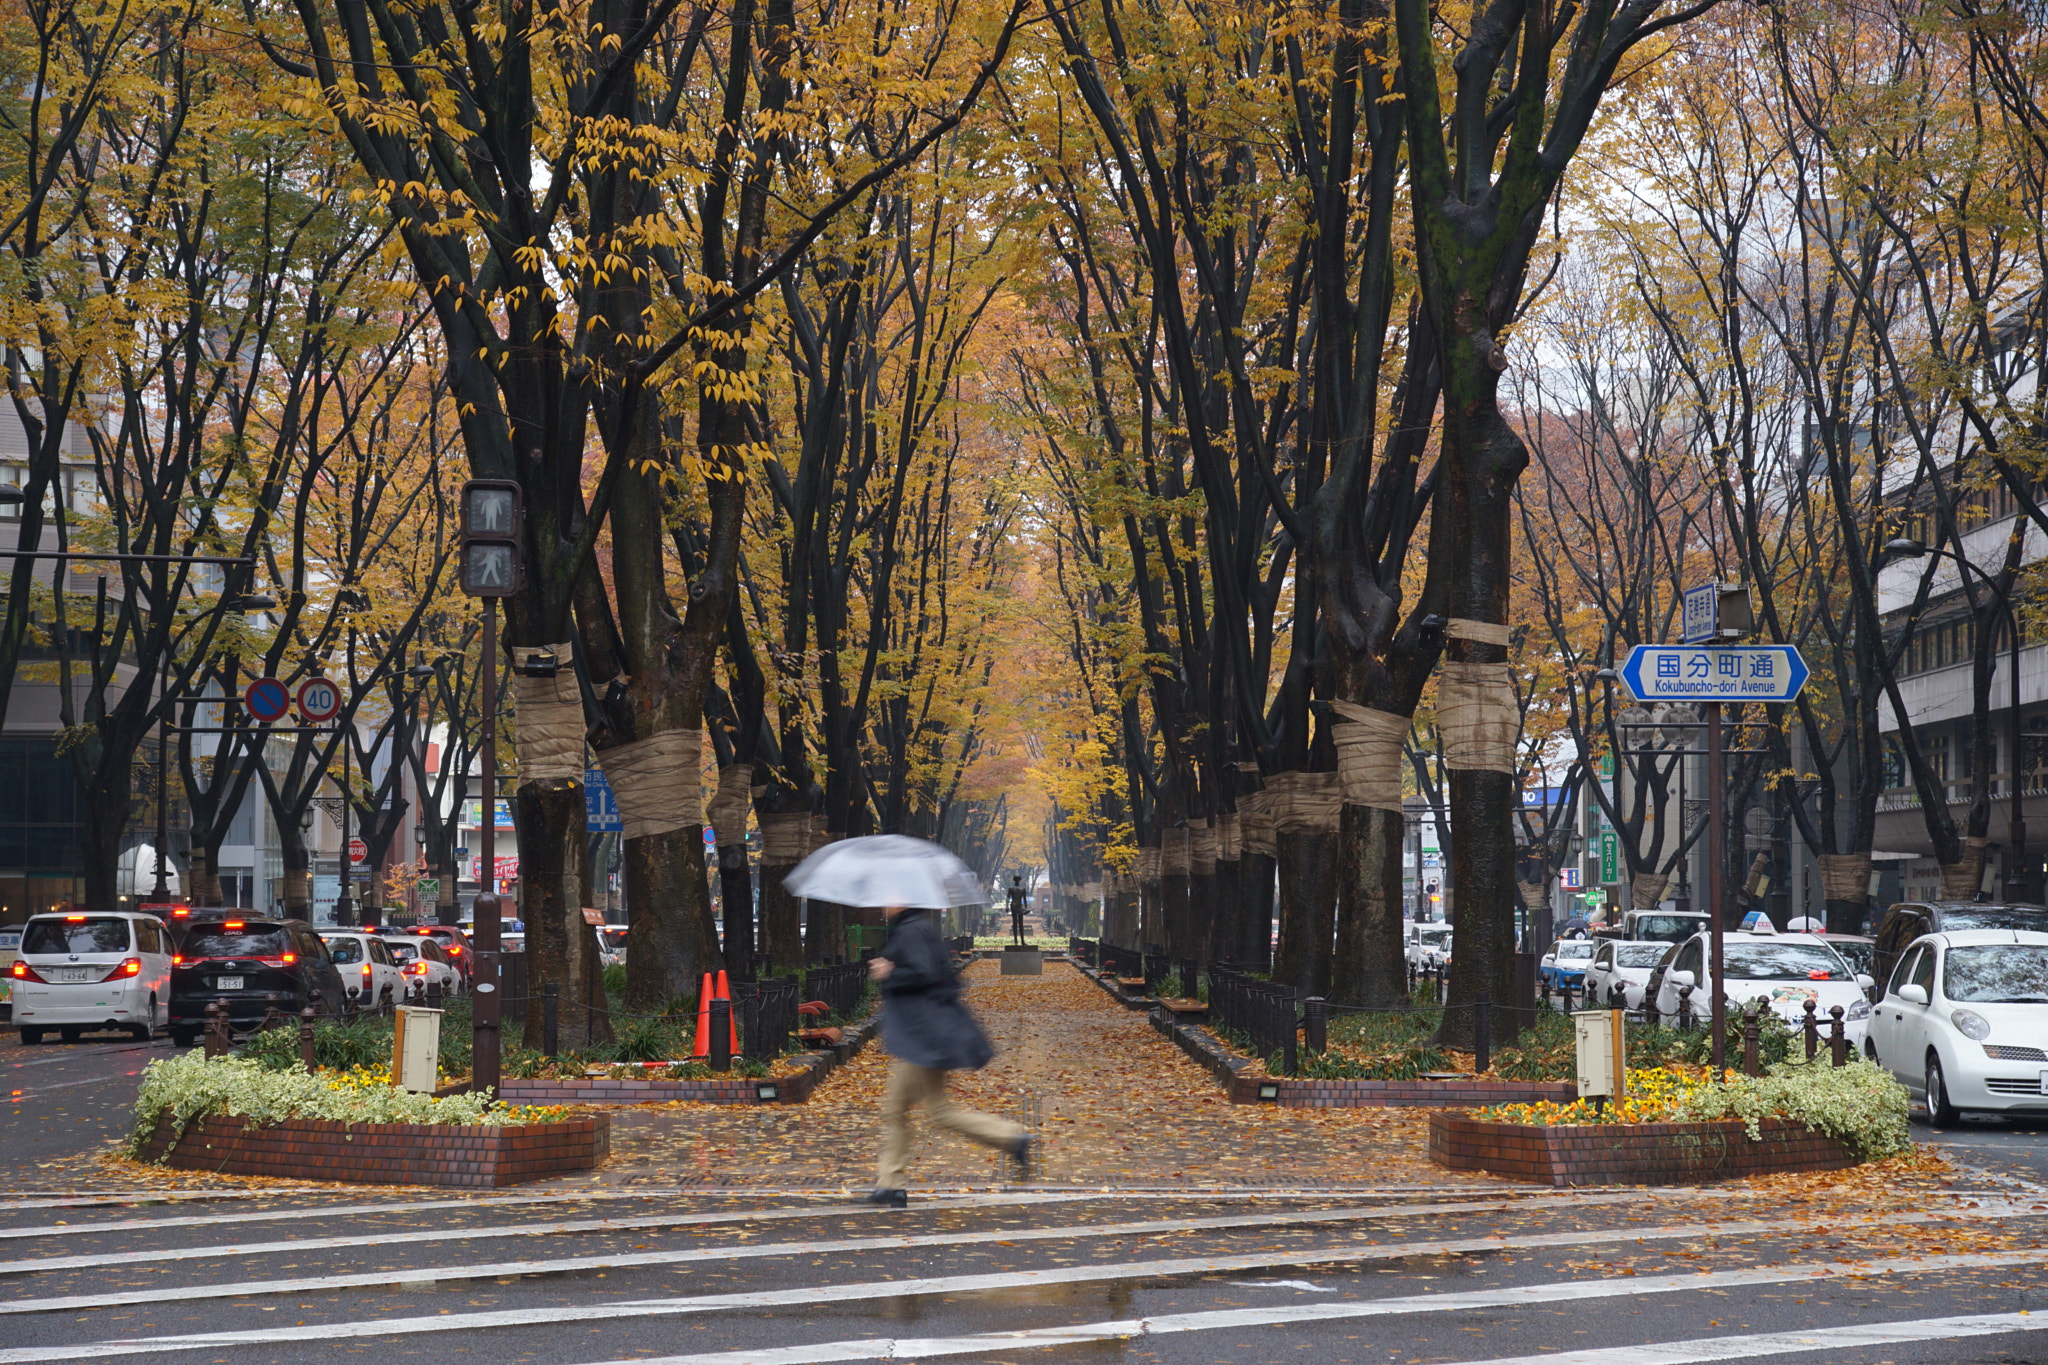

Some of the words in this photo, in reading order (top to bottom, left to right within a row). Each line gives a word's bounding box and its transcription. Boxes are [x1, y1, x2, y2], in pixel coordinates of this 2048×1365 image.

[1657, 654, 1775, 678] 国分町通
[1655, 679, 1737, 693] Kokubuncho-dori
[1741, 680, 1776, 693] Avenue
[307, 690, 331, 709] 40
